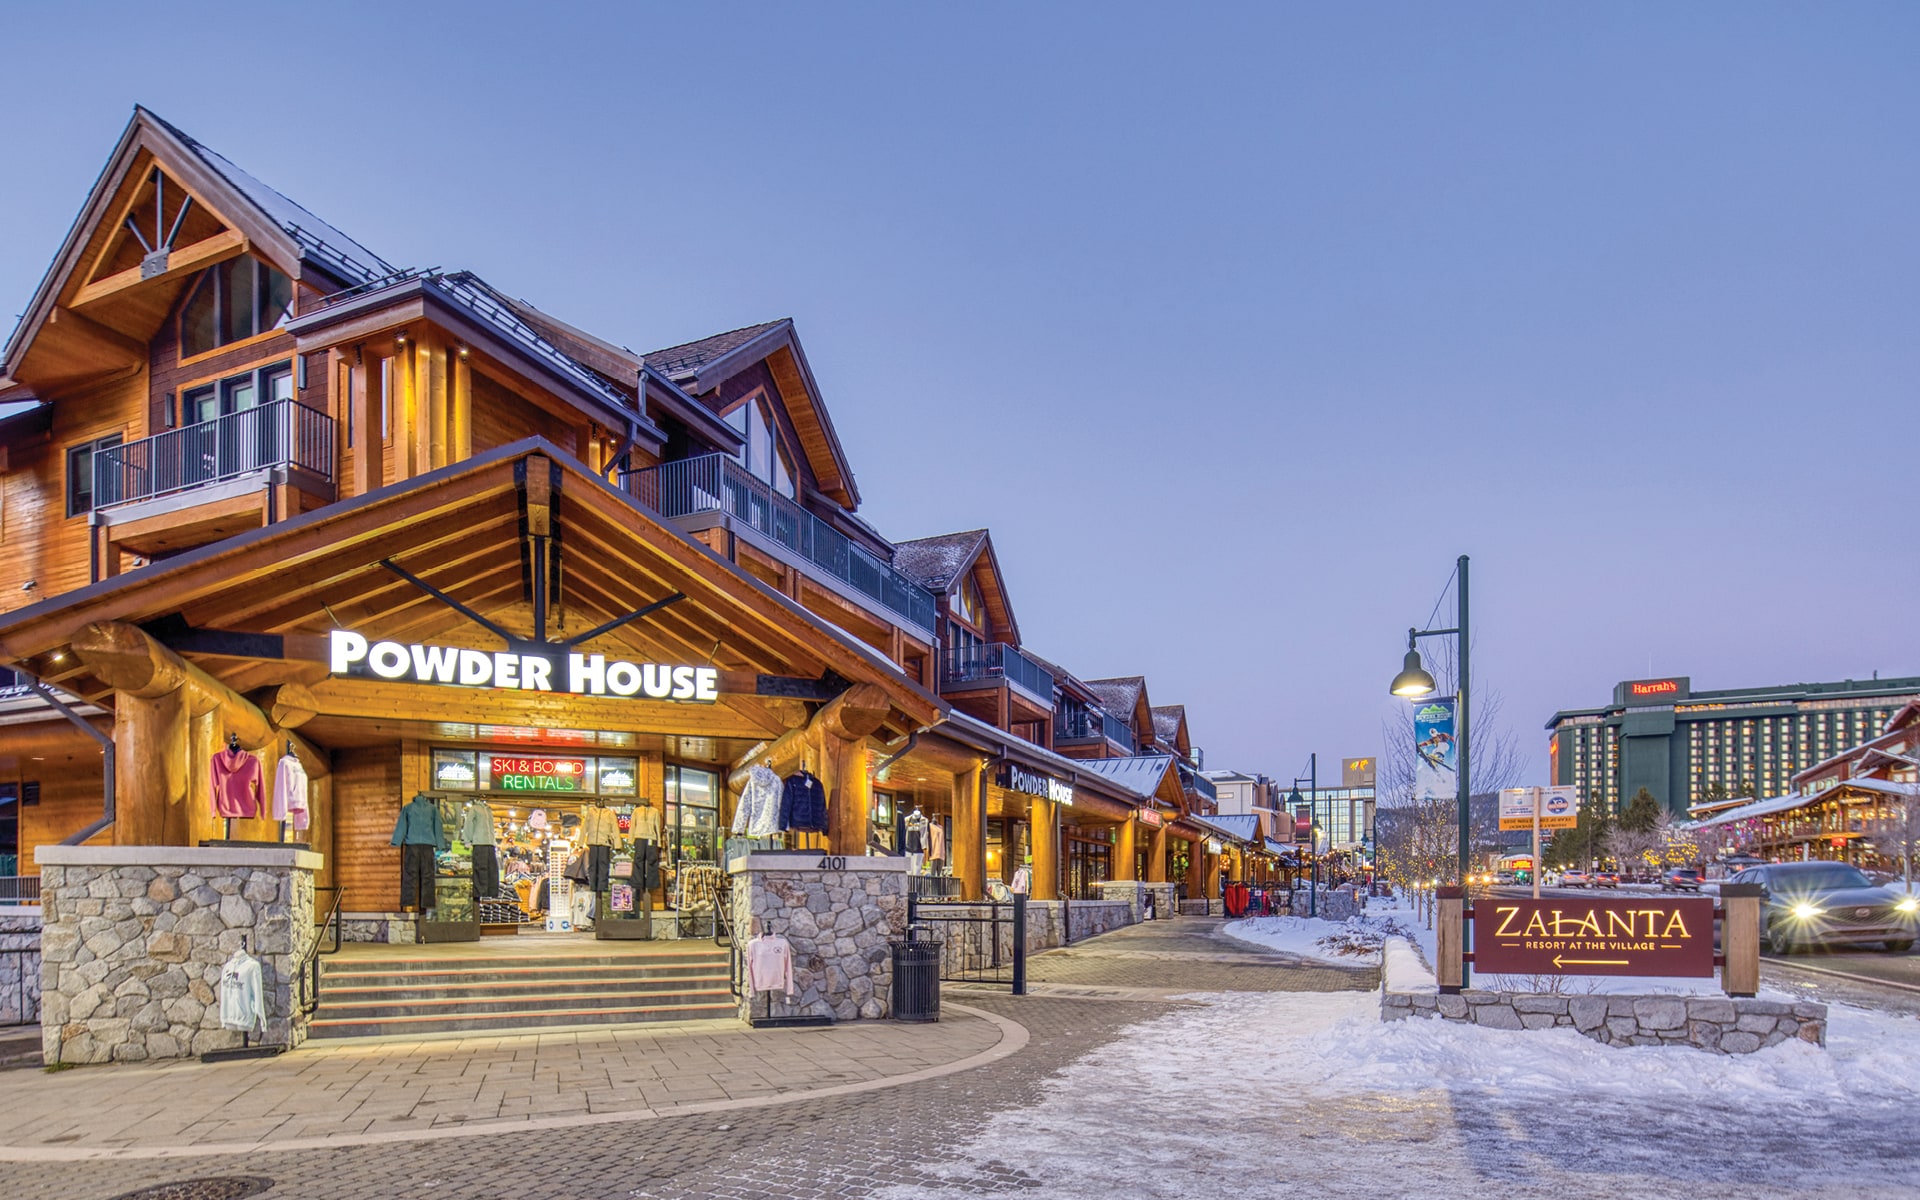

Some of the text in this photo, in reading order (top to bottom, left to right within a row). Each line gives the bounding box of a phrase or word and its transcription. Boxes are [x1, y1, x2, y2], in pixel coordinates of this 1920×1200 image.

[330, 630, 719, 700] POWDER HOUSE
[1632, 681, 1677, 694] Harrah's
[493, 759, 515, 772] SKI
[518, 760, 530, 773] &
[503, 774, 574, 790] RENTALS
[1011, 765, 1073, 806] POWDER HOUSE
[817, 857, 846, 870] 4101
[1495, 907, 1692, 938] ZALANTA
[1526, 941, 1566, 949] RESORT
[1586, 942, 1605, 950] THE
[1609, 942, 1655, 950] VILLAGE
